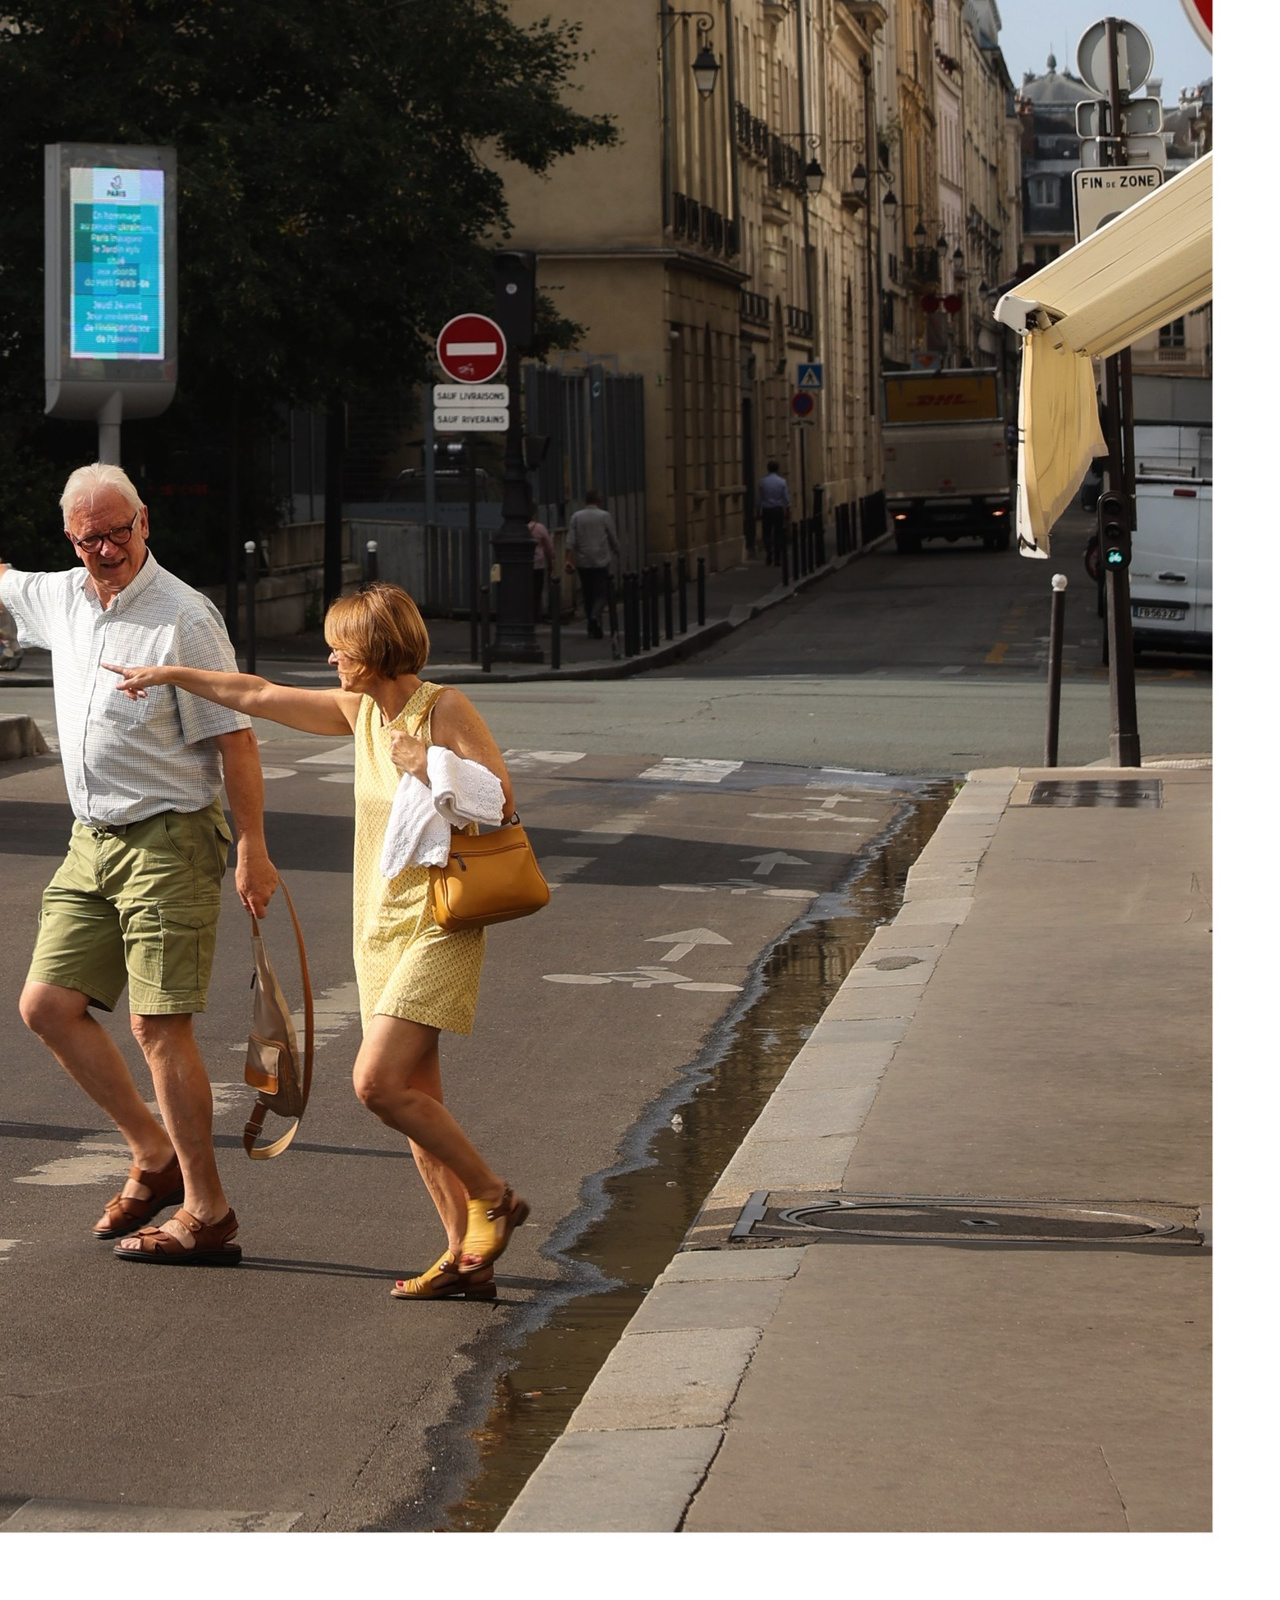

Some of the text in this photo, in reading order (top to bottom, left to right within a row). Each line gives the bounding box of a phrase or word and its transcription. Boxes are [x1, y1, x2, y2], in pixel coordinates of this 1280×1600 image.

[1082, 177, 1102, 189] FIN
[1120, 175, 1155, 187] ZONE
[437, 392, 505, 400] SAUF LIVRAISONS
[916, 394, 964, 406] DHL
[437, 415, 505, 424] SAUF RIVERAINS
